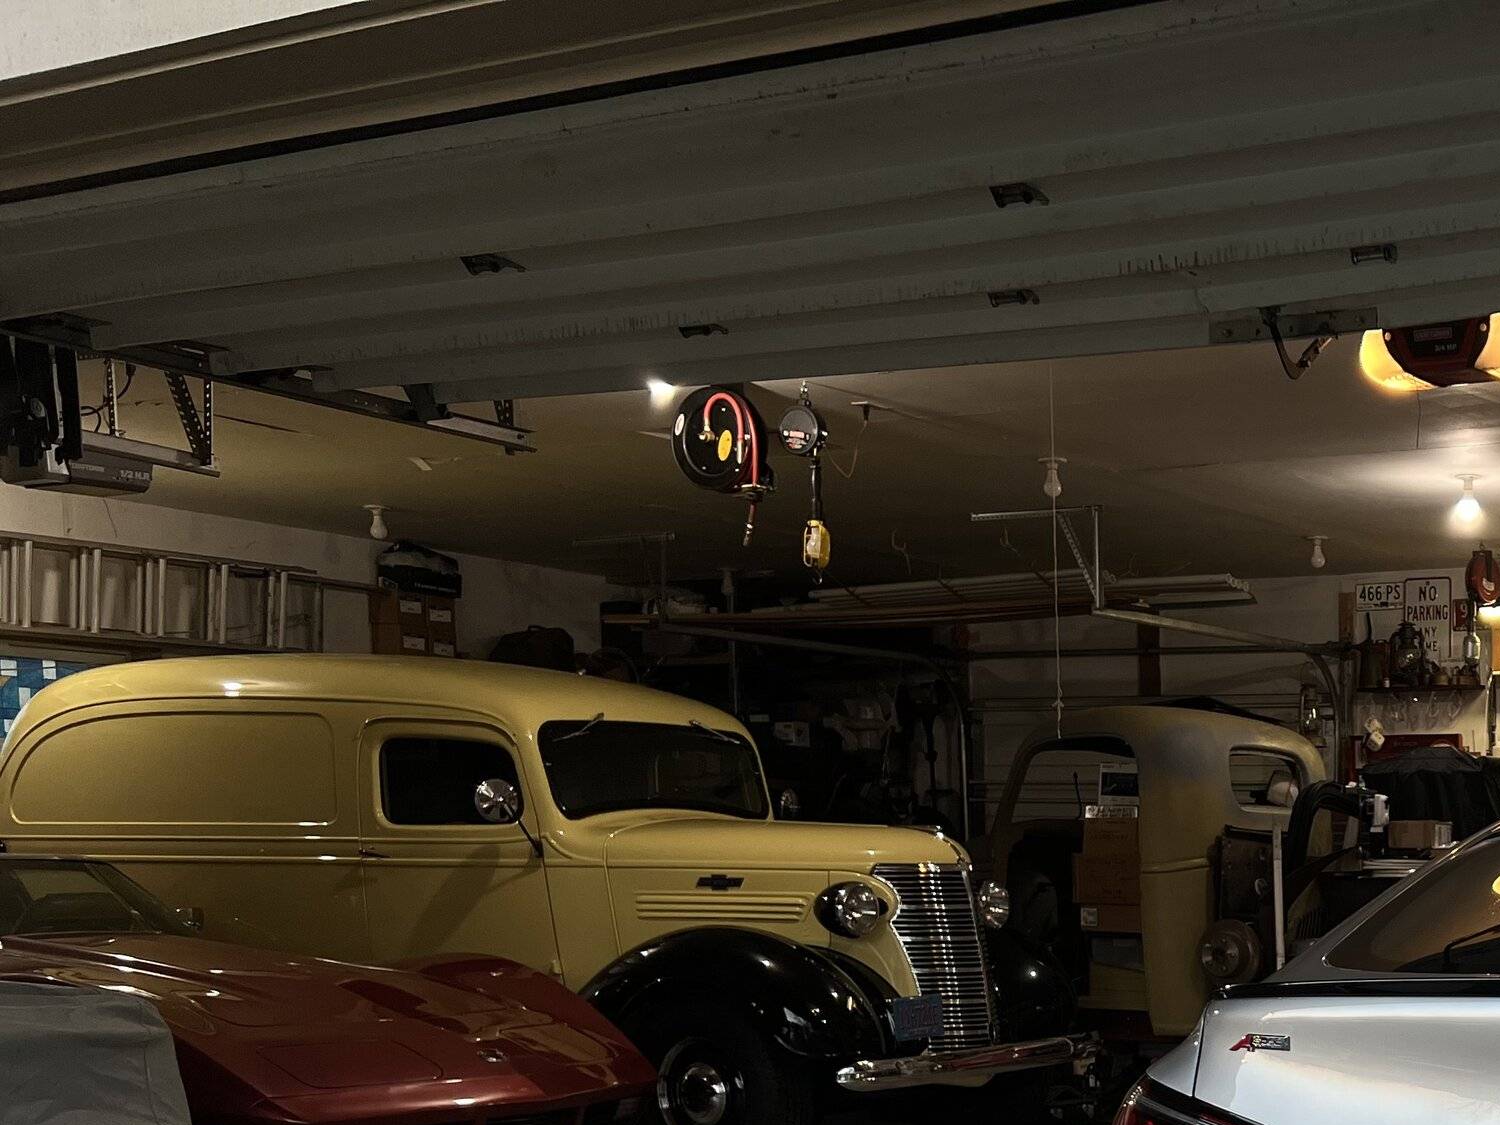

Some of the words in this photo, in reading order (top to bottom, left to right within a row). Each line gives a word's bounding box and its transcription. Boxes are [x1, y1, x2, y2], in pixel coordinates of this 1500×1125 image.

[1359, 586, 1383, 602] 466
[1386, 585, 1401, 601] PS
[1419, 585, 1437, 601] NO
[1407, 604, 1449, 622] PARKING
